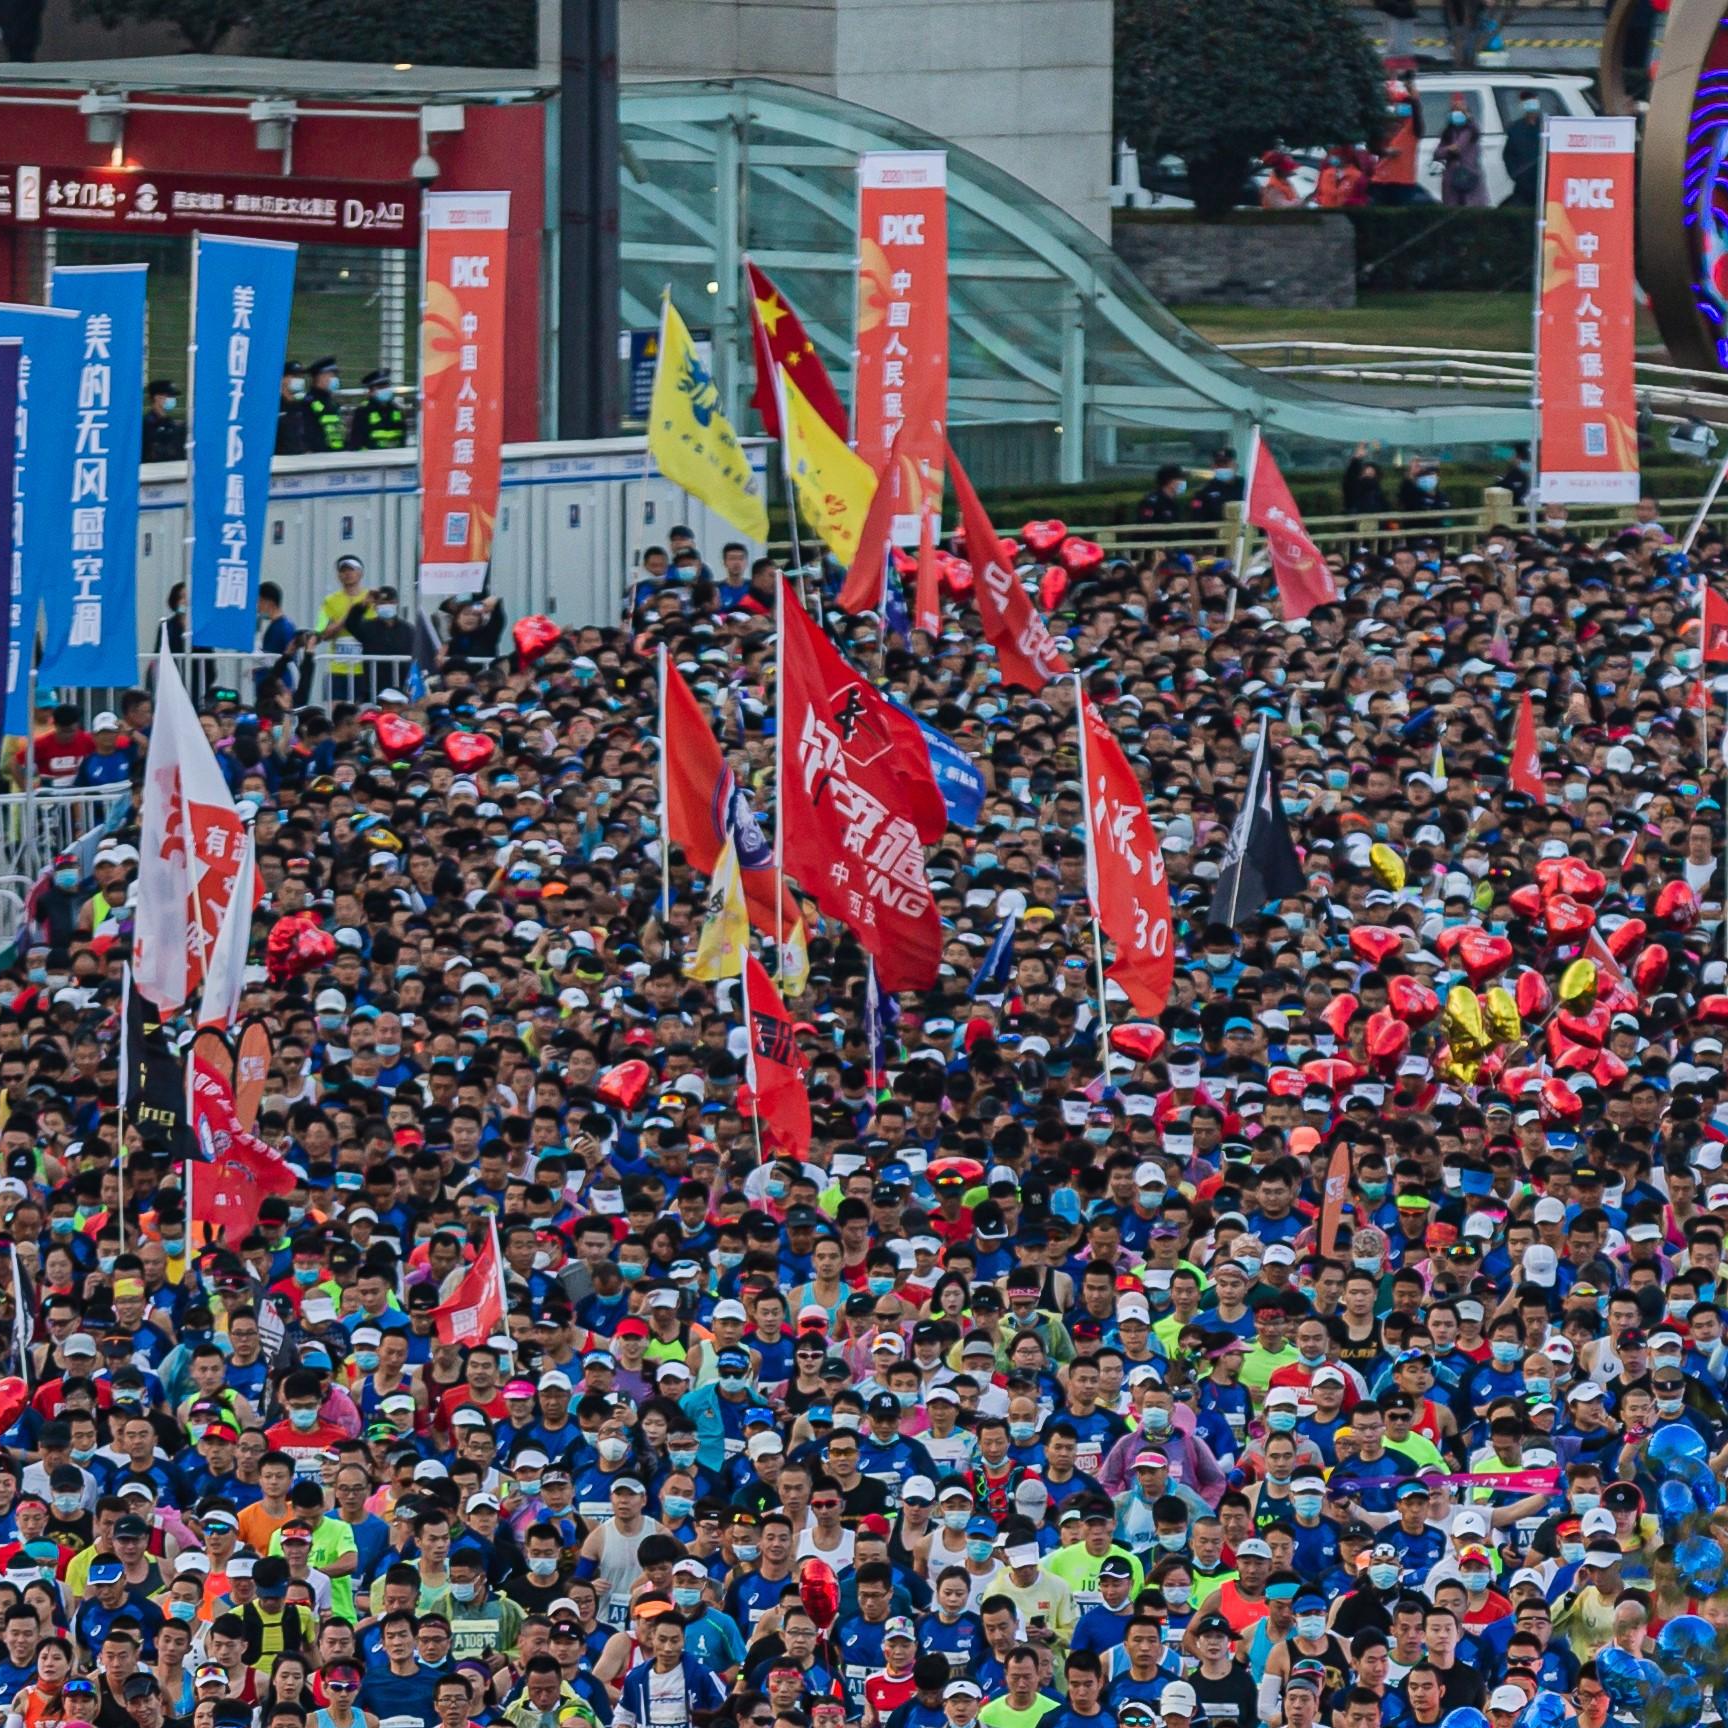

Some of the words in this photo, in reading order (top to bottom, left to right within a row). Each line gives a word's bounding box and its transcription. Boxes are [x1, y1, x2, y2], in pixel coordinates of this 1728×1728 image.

[1564, 178, 1614, 209] PICC
[376, 202, 404, 221] 入口
[879, 214, 925, 245] PICC
[450, 256, 489, 288] PICC
[1575, 232, 1604, 408] 中国人民保险
[447, 314, 478, 497] 中国人民保险
[70, 314, 112, 647] 美的无风感空调
[831, 861, 849, 886] 中
